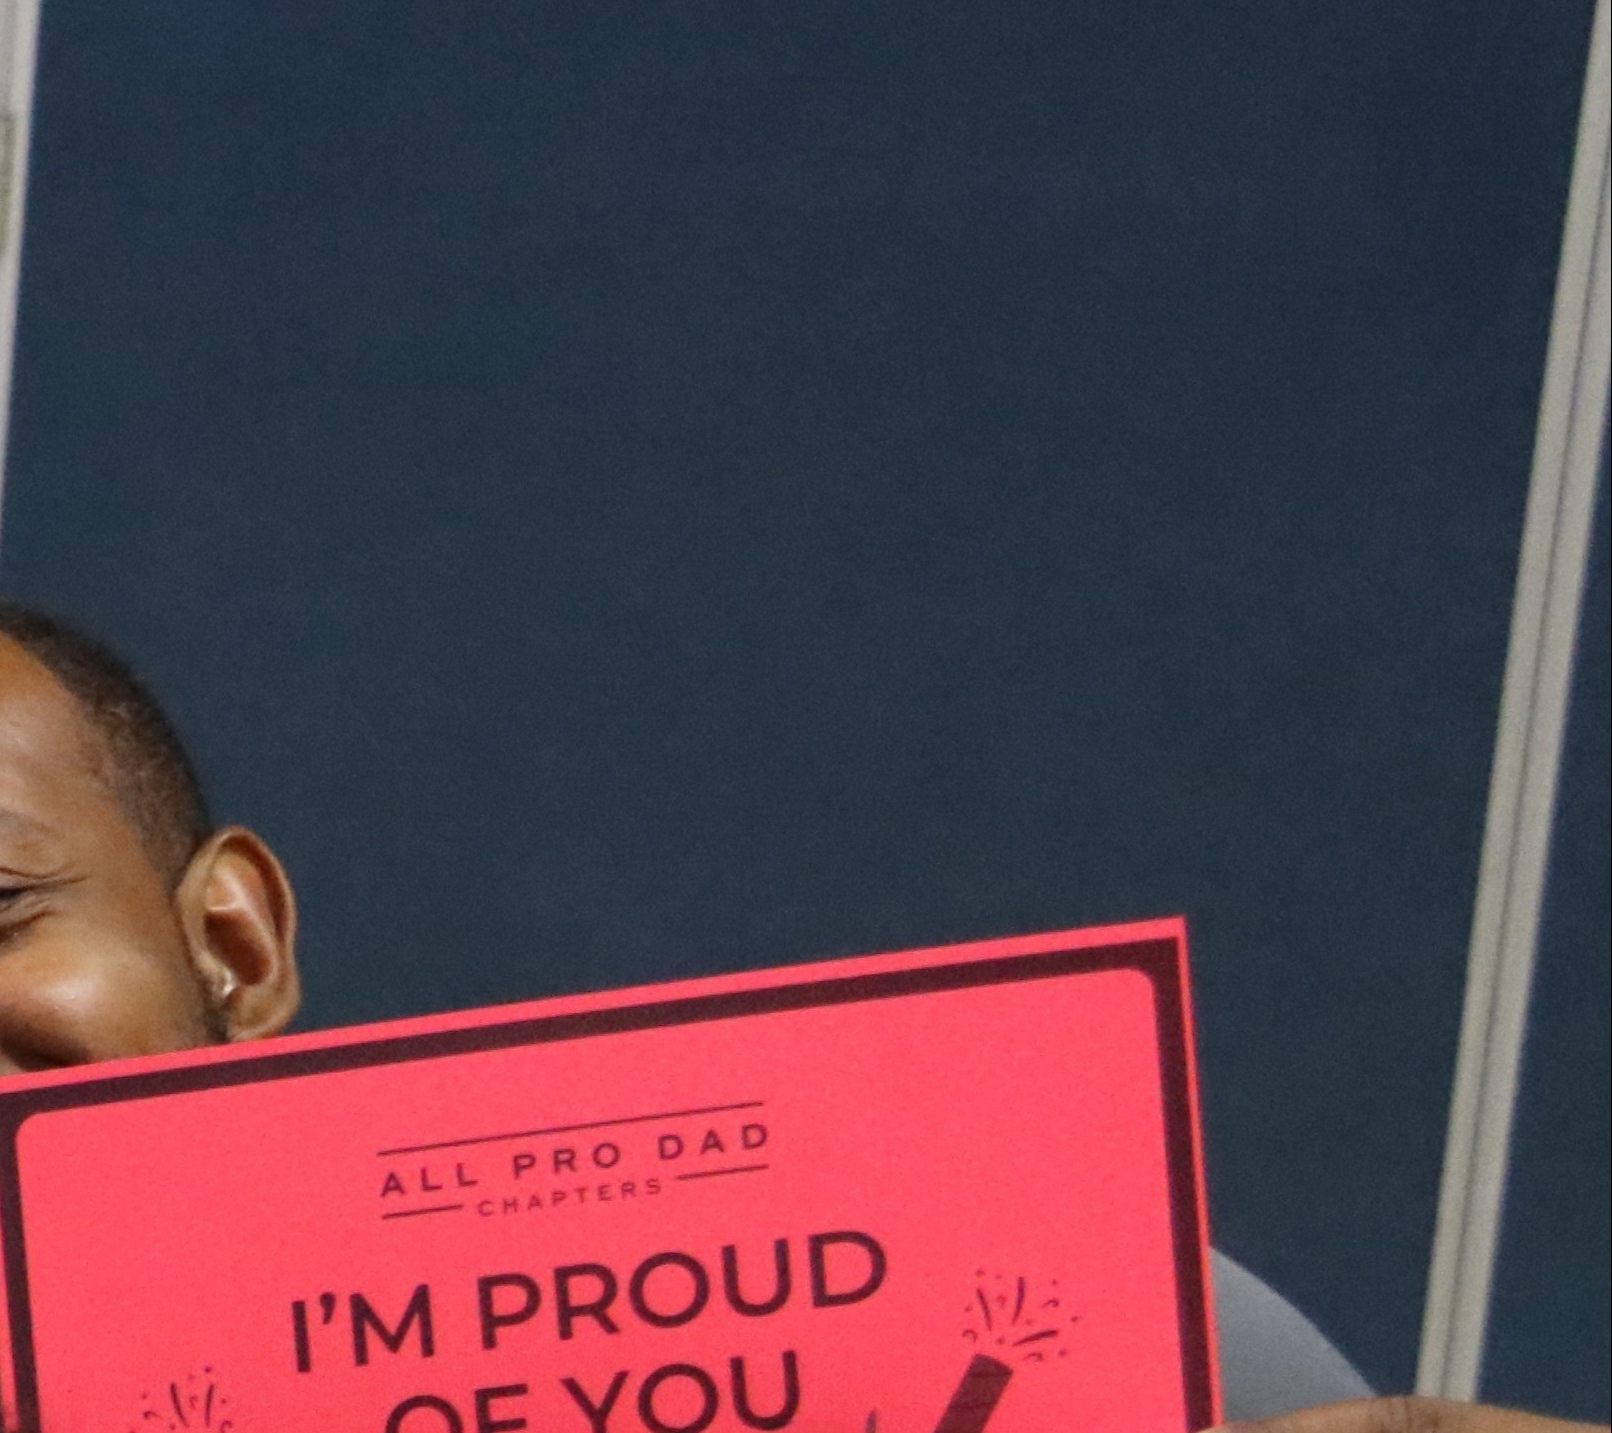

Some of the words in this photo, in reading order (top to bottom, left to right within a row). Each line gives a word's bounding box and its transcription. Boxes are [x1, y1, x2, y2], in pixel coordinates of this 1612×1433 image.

[380, 1162, 479, 1198] ALL
[513, 1142, 622, 1181] PRO
[658, 1123, 768, 1161] DAD
[476, 1177, 663, 1218] CHAPTERS
[290, 1283, 436, 1374] I'M
[476, 1230, 888, 1351] PROUD
